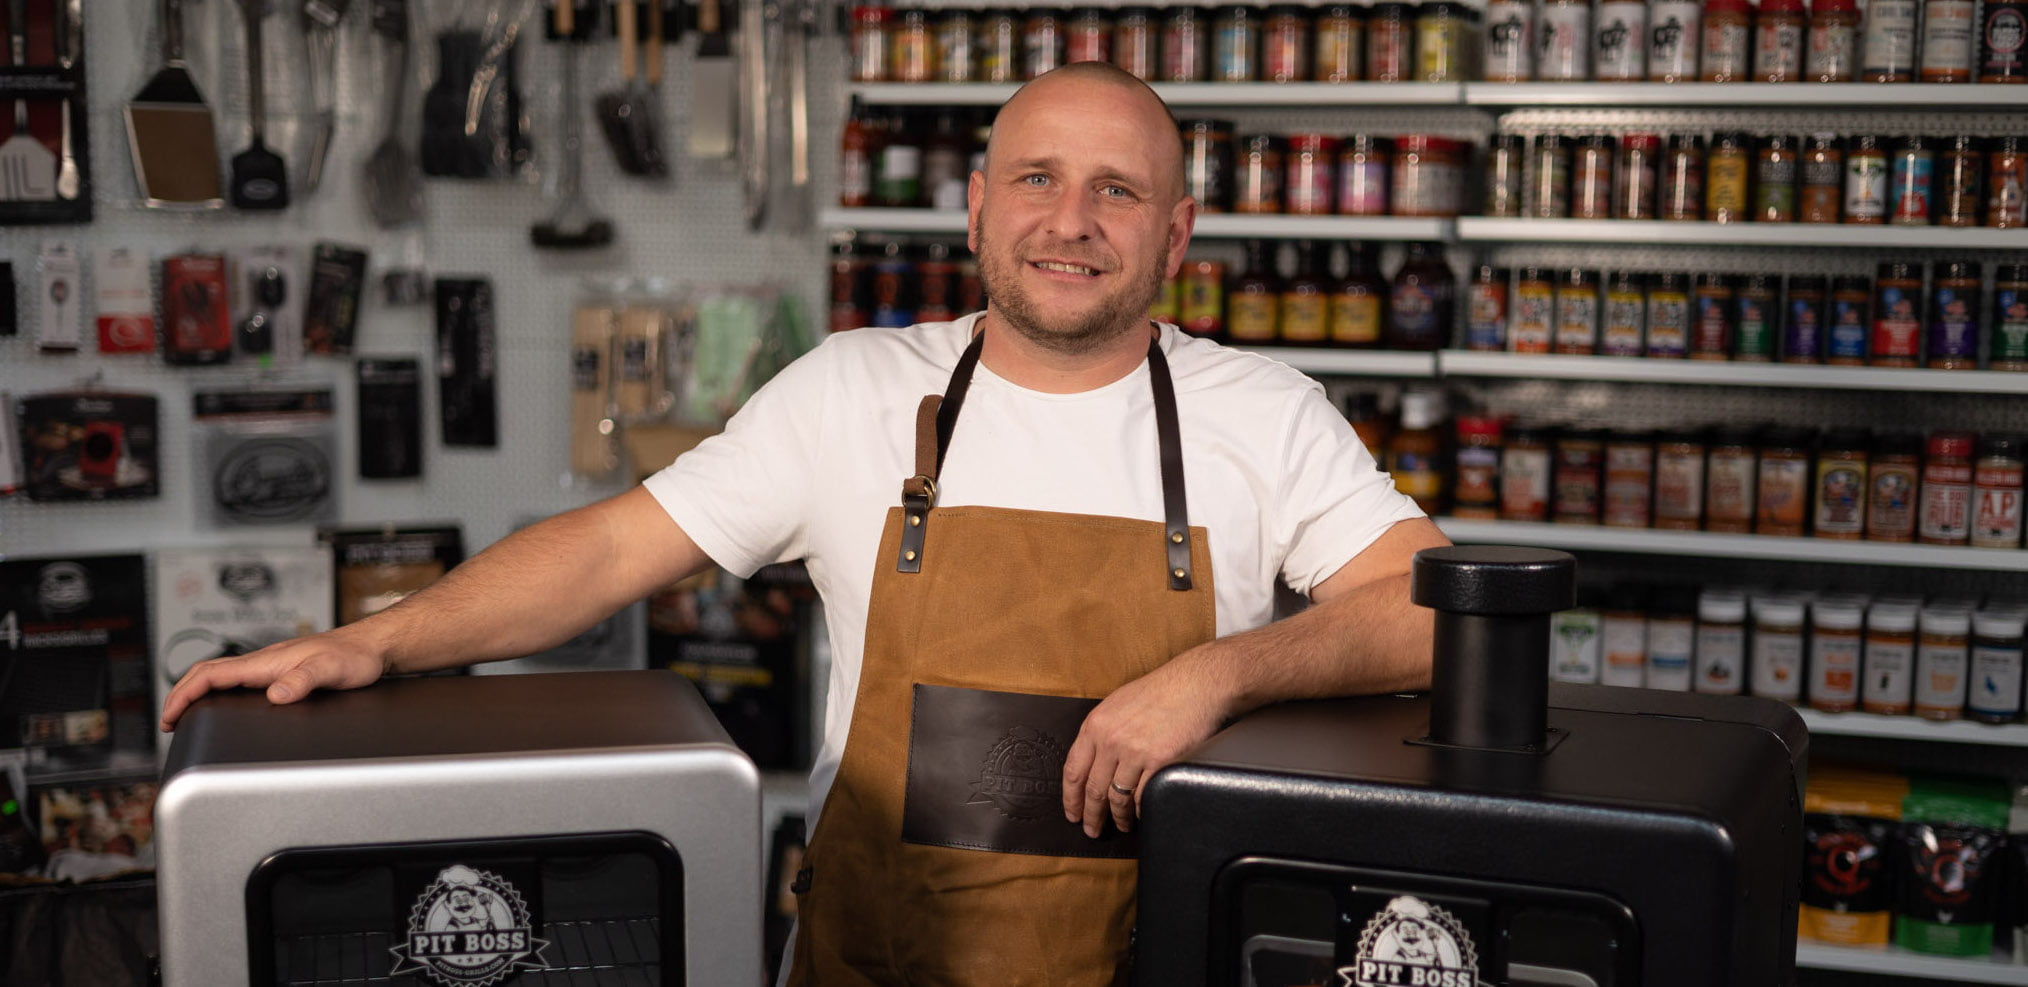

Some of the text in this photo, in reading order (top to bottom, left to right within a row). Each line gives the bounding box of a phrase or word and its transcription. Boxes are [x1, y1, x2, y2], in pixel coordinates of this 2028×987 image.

[981, 776, 1016, 793] PIT
[414, 931, 525, 954] PIT BOSS
[1361, 961, 1472, 987] PIT BOSS
